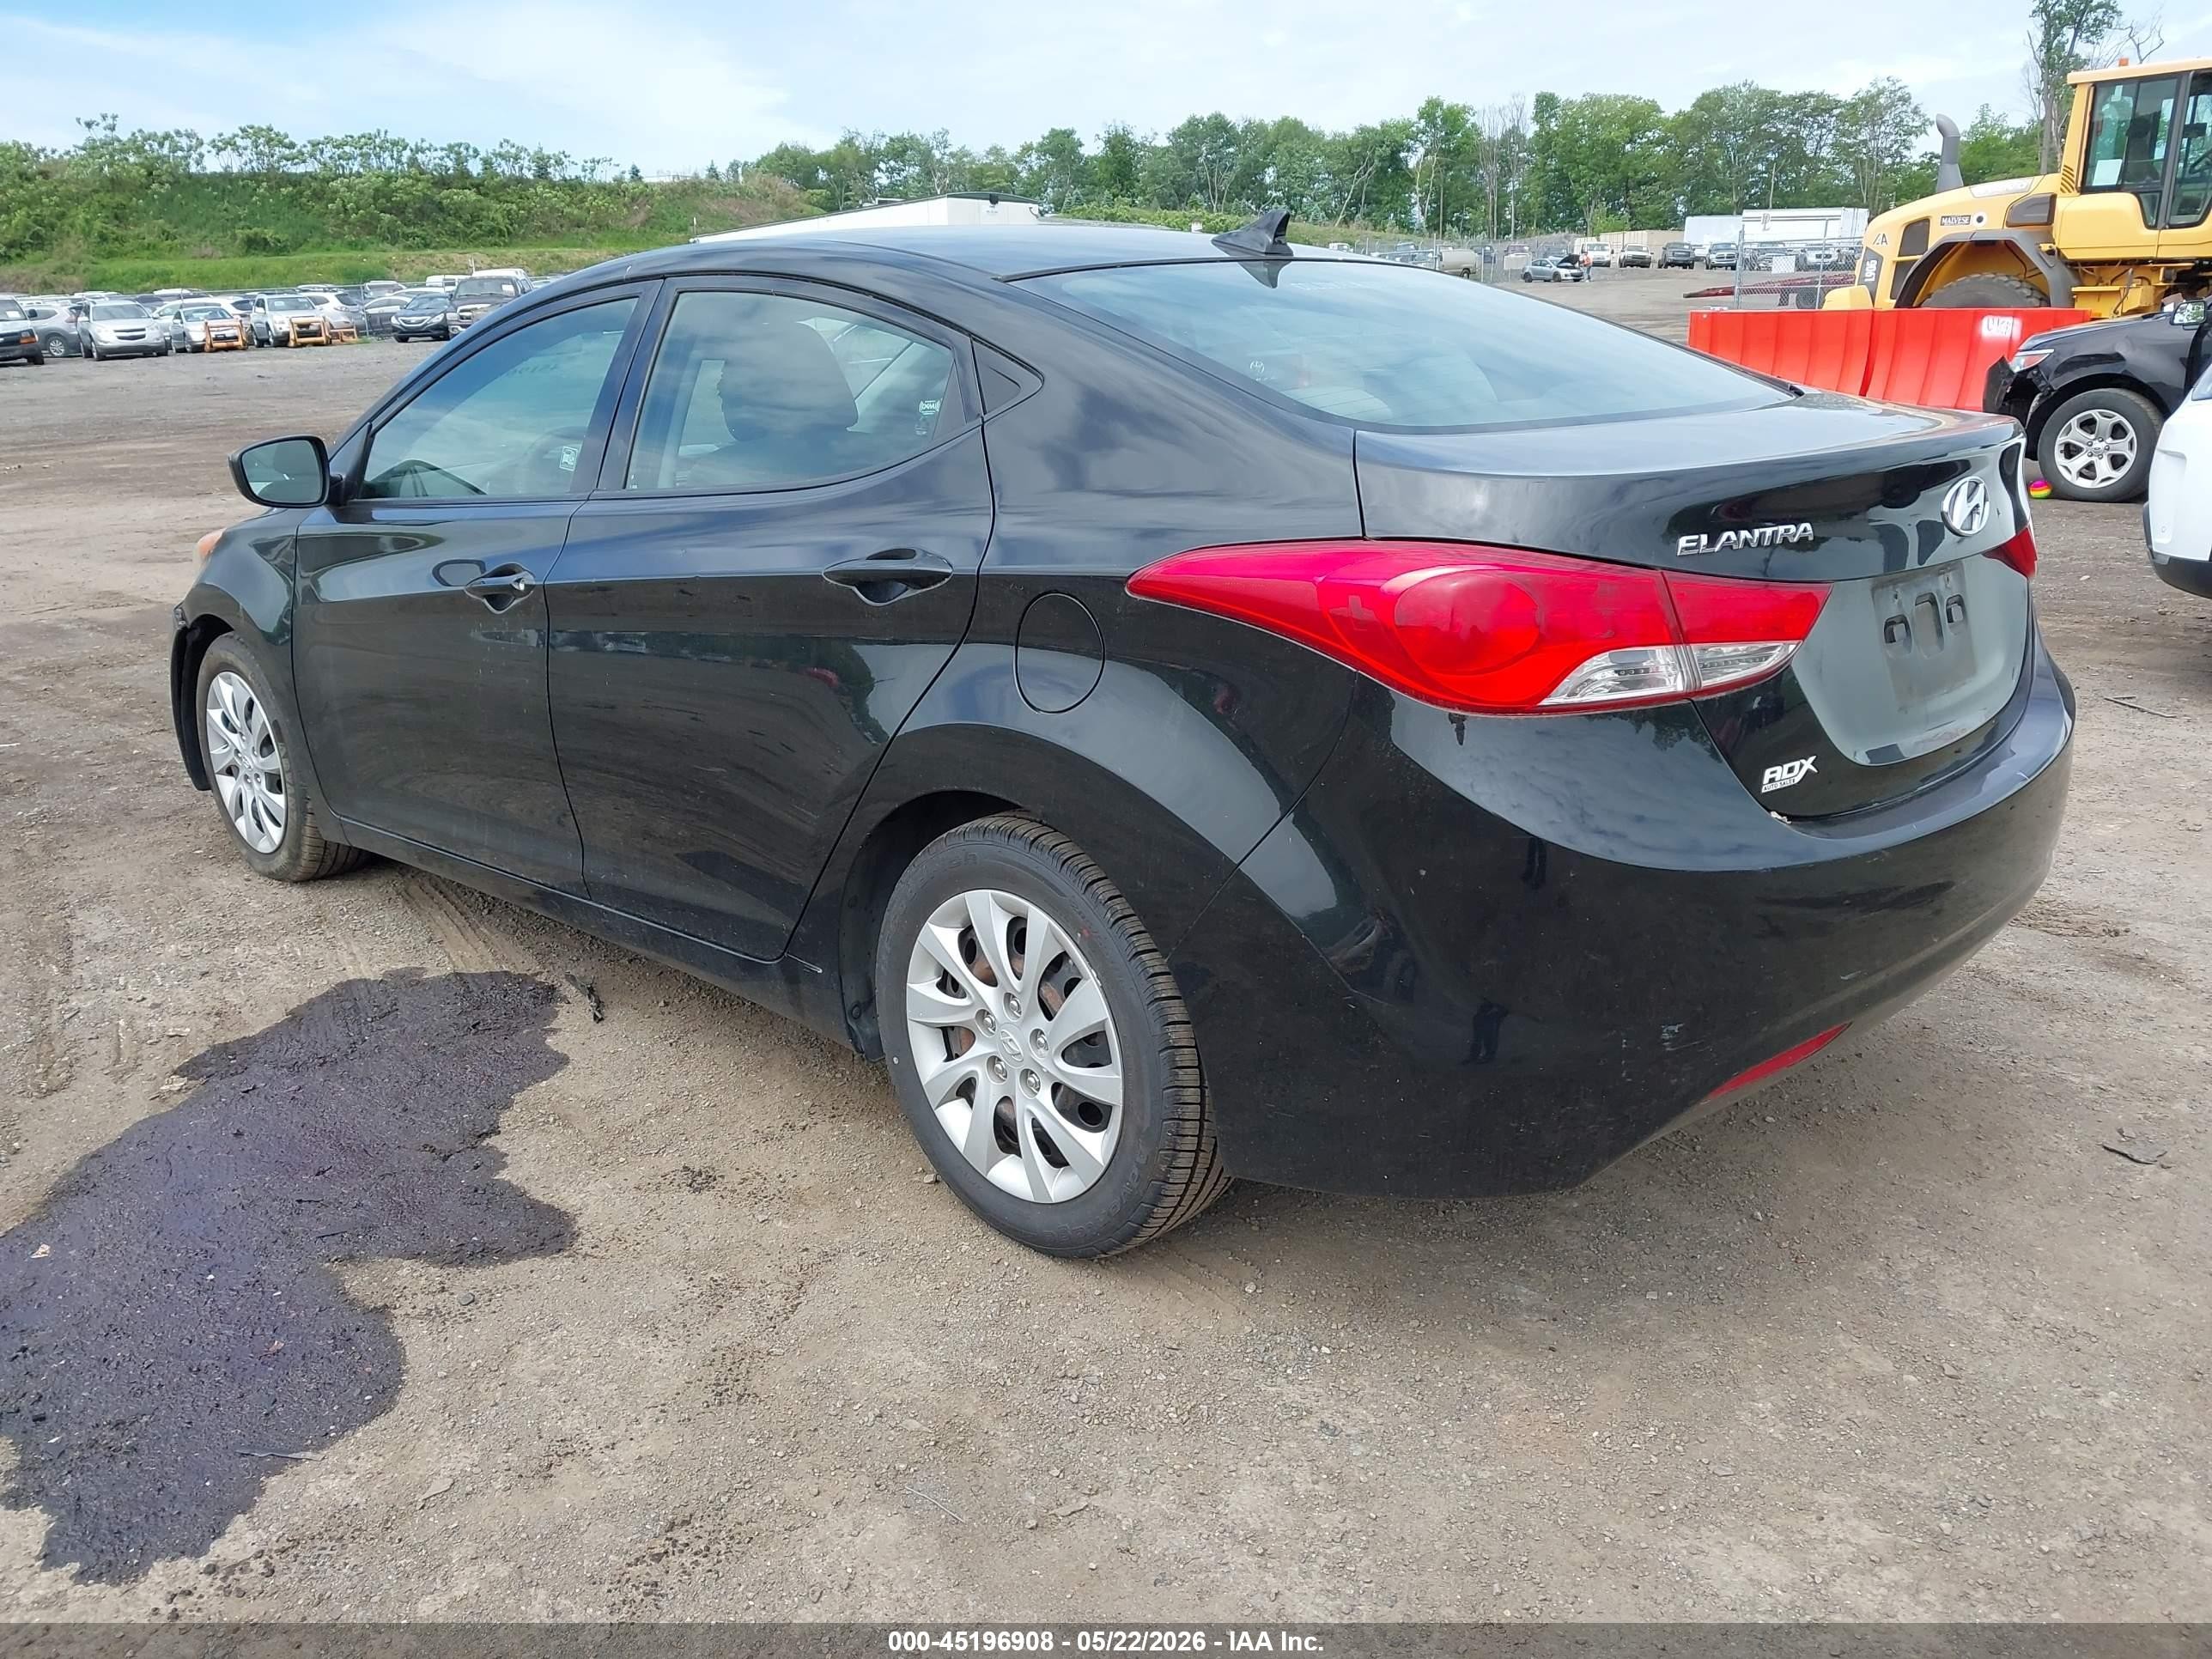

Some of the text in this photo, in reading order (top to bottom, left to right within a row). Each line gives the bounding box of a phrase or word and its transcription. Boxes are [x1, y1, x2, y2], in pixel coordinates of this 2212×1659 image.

[1942, 216, 1970, 225] MALVESE
[1677, 522, 1814, 556] ELANTRA
[1763, 756, 1818, 785] ADX
[1763, 782, 1778, 791] AUTO
